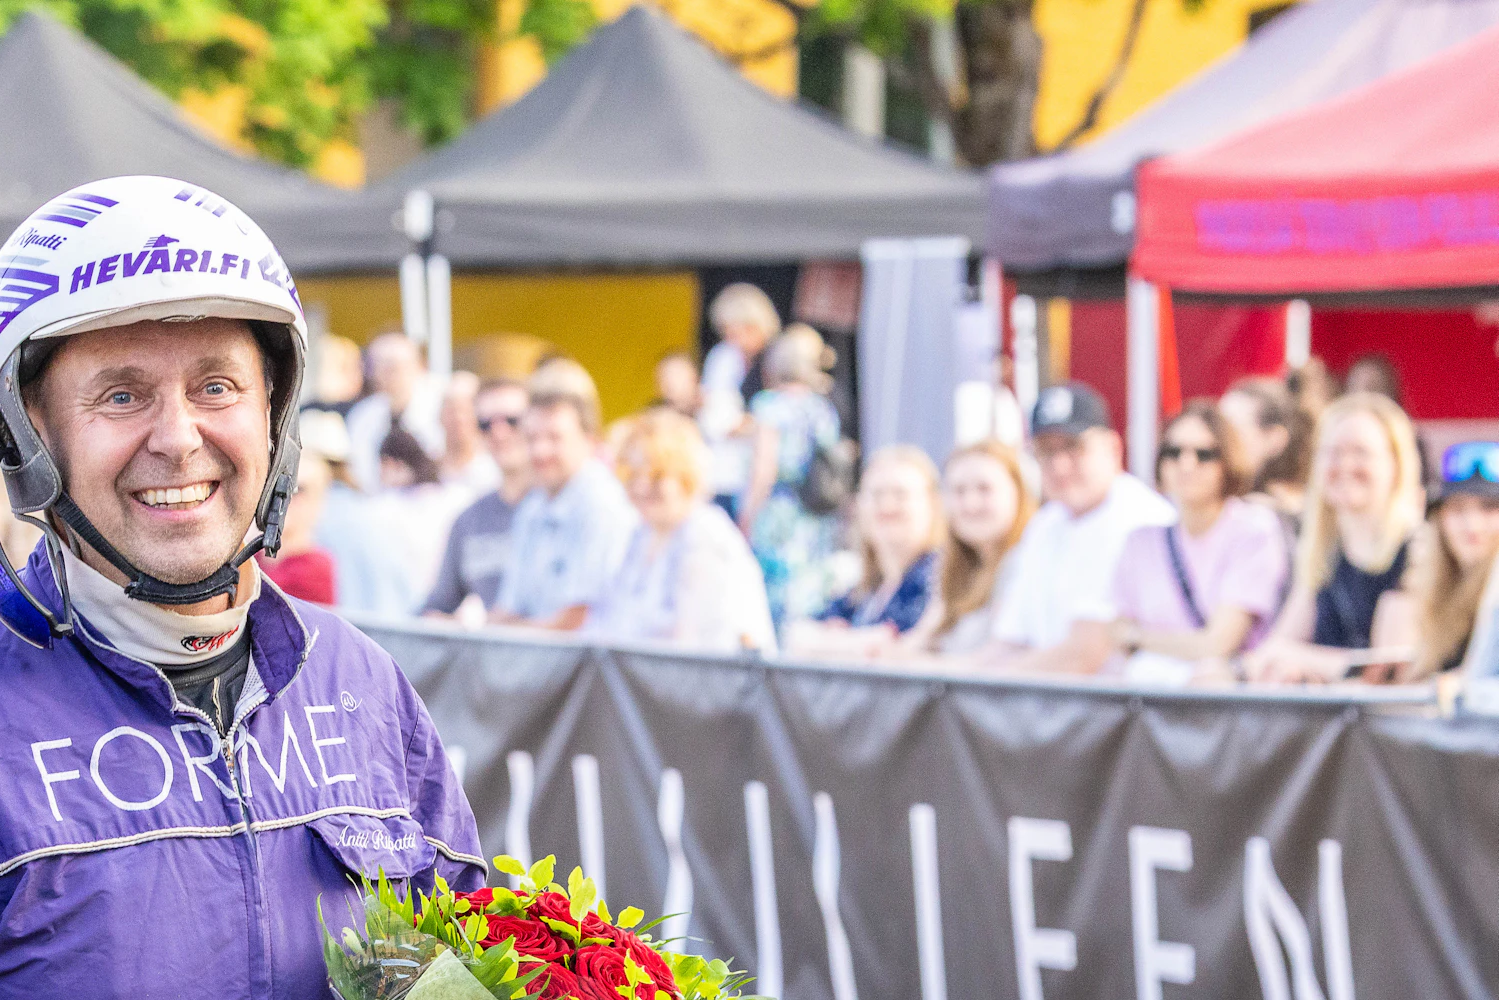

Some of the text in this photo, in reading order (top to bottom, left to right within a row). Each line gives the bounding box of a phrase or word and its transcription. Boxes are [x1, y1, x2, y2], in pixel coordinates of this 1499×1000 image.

[69, 248, 251, 295] HEVARI.FI
[31, 704, 357, 823] FORME
[335, 825, 417, 857] Antti Ripatti
